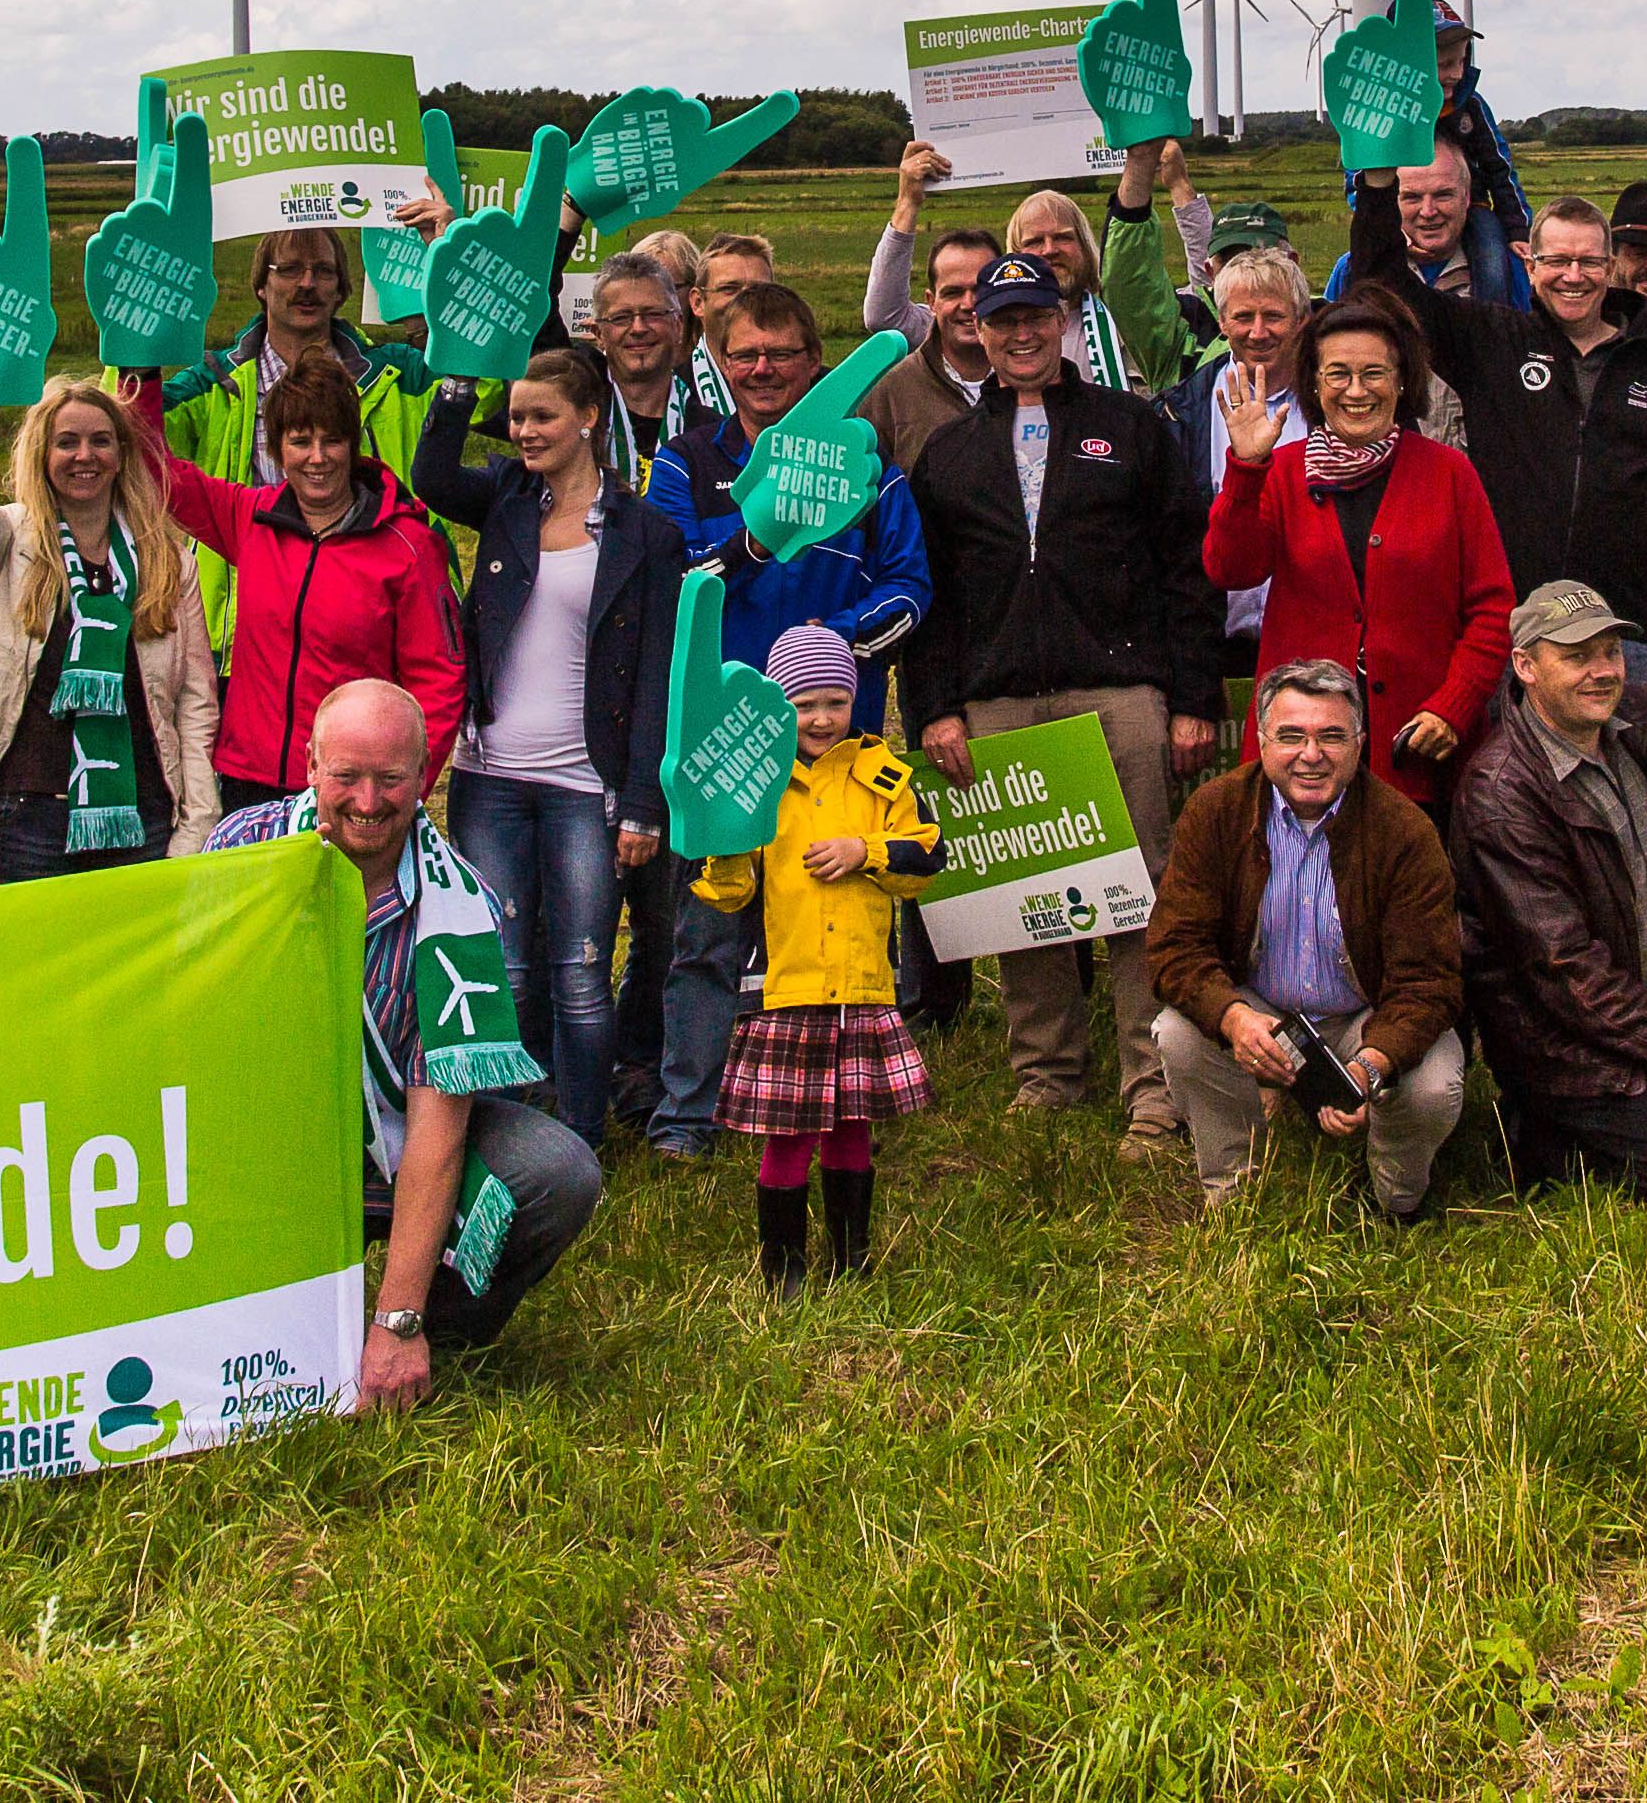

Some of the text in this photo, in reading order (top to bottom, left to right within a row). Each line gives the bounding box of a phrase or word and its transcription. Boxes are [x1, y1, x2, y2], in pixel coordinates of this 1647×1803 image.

[919, 16, 1090, 49] Energiewende-Charta
[220, 76, 289, 119] sind
[298, 74, 347, 111] die
[1105, 85, 1154, 115] HAND
[1111, 59, 1184, 99] BÜRGER-
[1342, 102, 1394, 139] HAND
[1350, 77, 1430, 125] BÜRGER-
[209, 118, 397, 167] ergiewende!
[591, 132, 620, 187] HAND
[290, 182, 336, 198] WENDE
[460, 174, 505, 211] ind
[617, 128, 650, 215] BÜRGER-
[103, 293, 160, 337] HAND
[114, 268, 201, 322] BÜRGER-
[454, 275, 531, 337] BÜRGER-
[438, 300, 495, 347] HAND
[778, 462, 861, 504] BÜRGER-
[774, 494, 827, 528] HAND
[713, 711, 790, 794] BÜRGER-
[733, 755, 781, 815] HAND
[1004, 761, 1049, 808] die
[947, 801, 1107, 876] ergiewende!
[1024, 891, 1064, 912] WENDE
[1103, 885, 1132, 900] 100%.
[1108, 894, 1151, 915] Dezentral.
[1113, 909, 1149, 929] Gerecht.
[221, 1348, 296, 1387] 100%.
